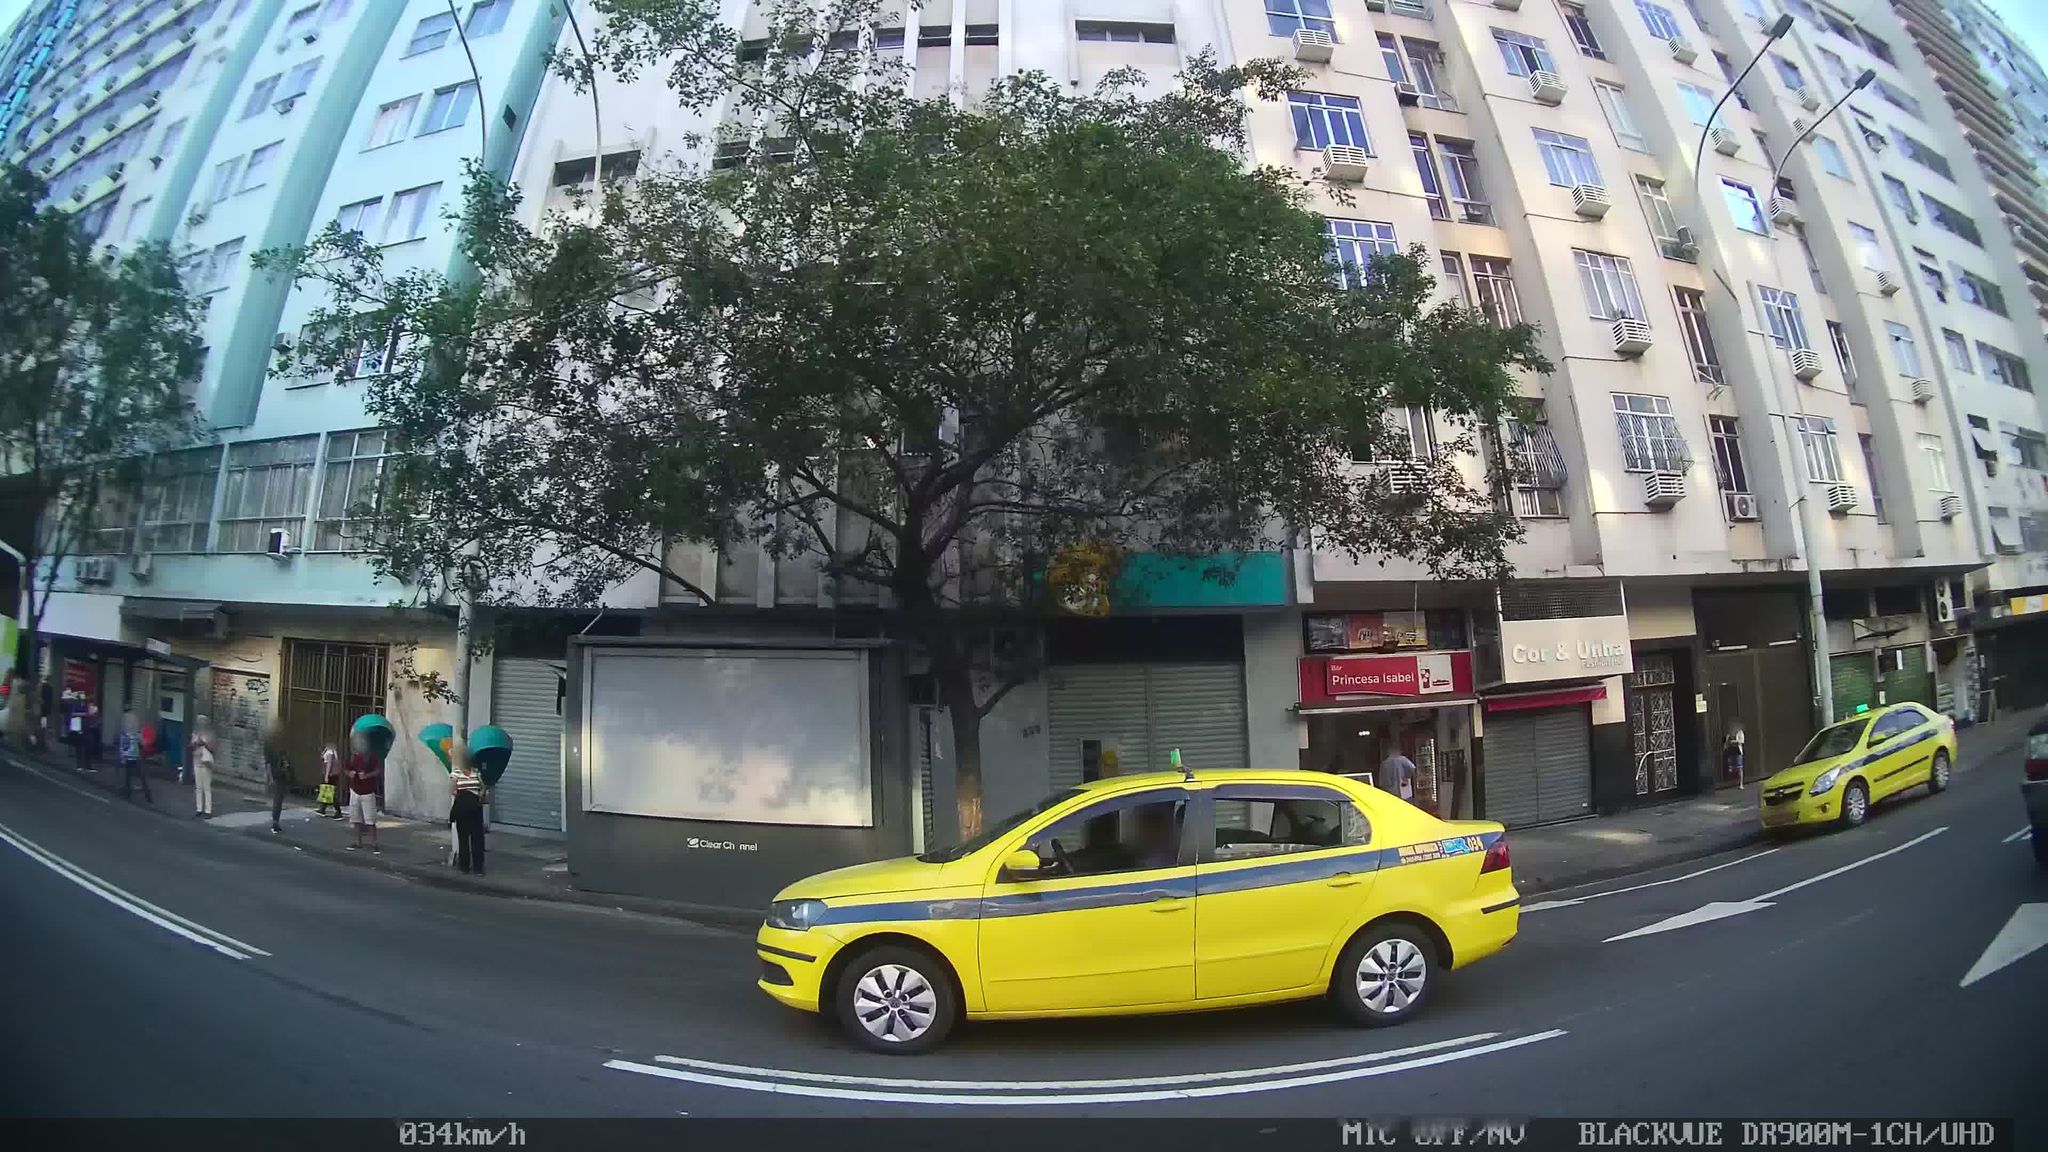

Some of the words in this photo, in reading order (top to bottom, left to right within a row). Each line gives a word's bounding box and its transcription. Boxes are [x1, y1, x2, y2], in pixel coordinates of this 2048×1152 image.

[1512, 643, 1549, 664] Cor
[1556, 640, 1569, 661] &
[1577, 638, 1625, 659] Unha
[1332, 674, 1380, 686] Princesa
[1383, 672, 1415, 684] Isabel
[700, 839, 722, 849] Clear
[723, 841, 758, 851] Chnnel
